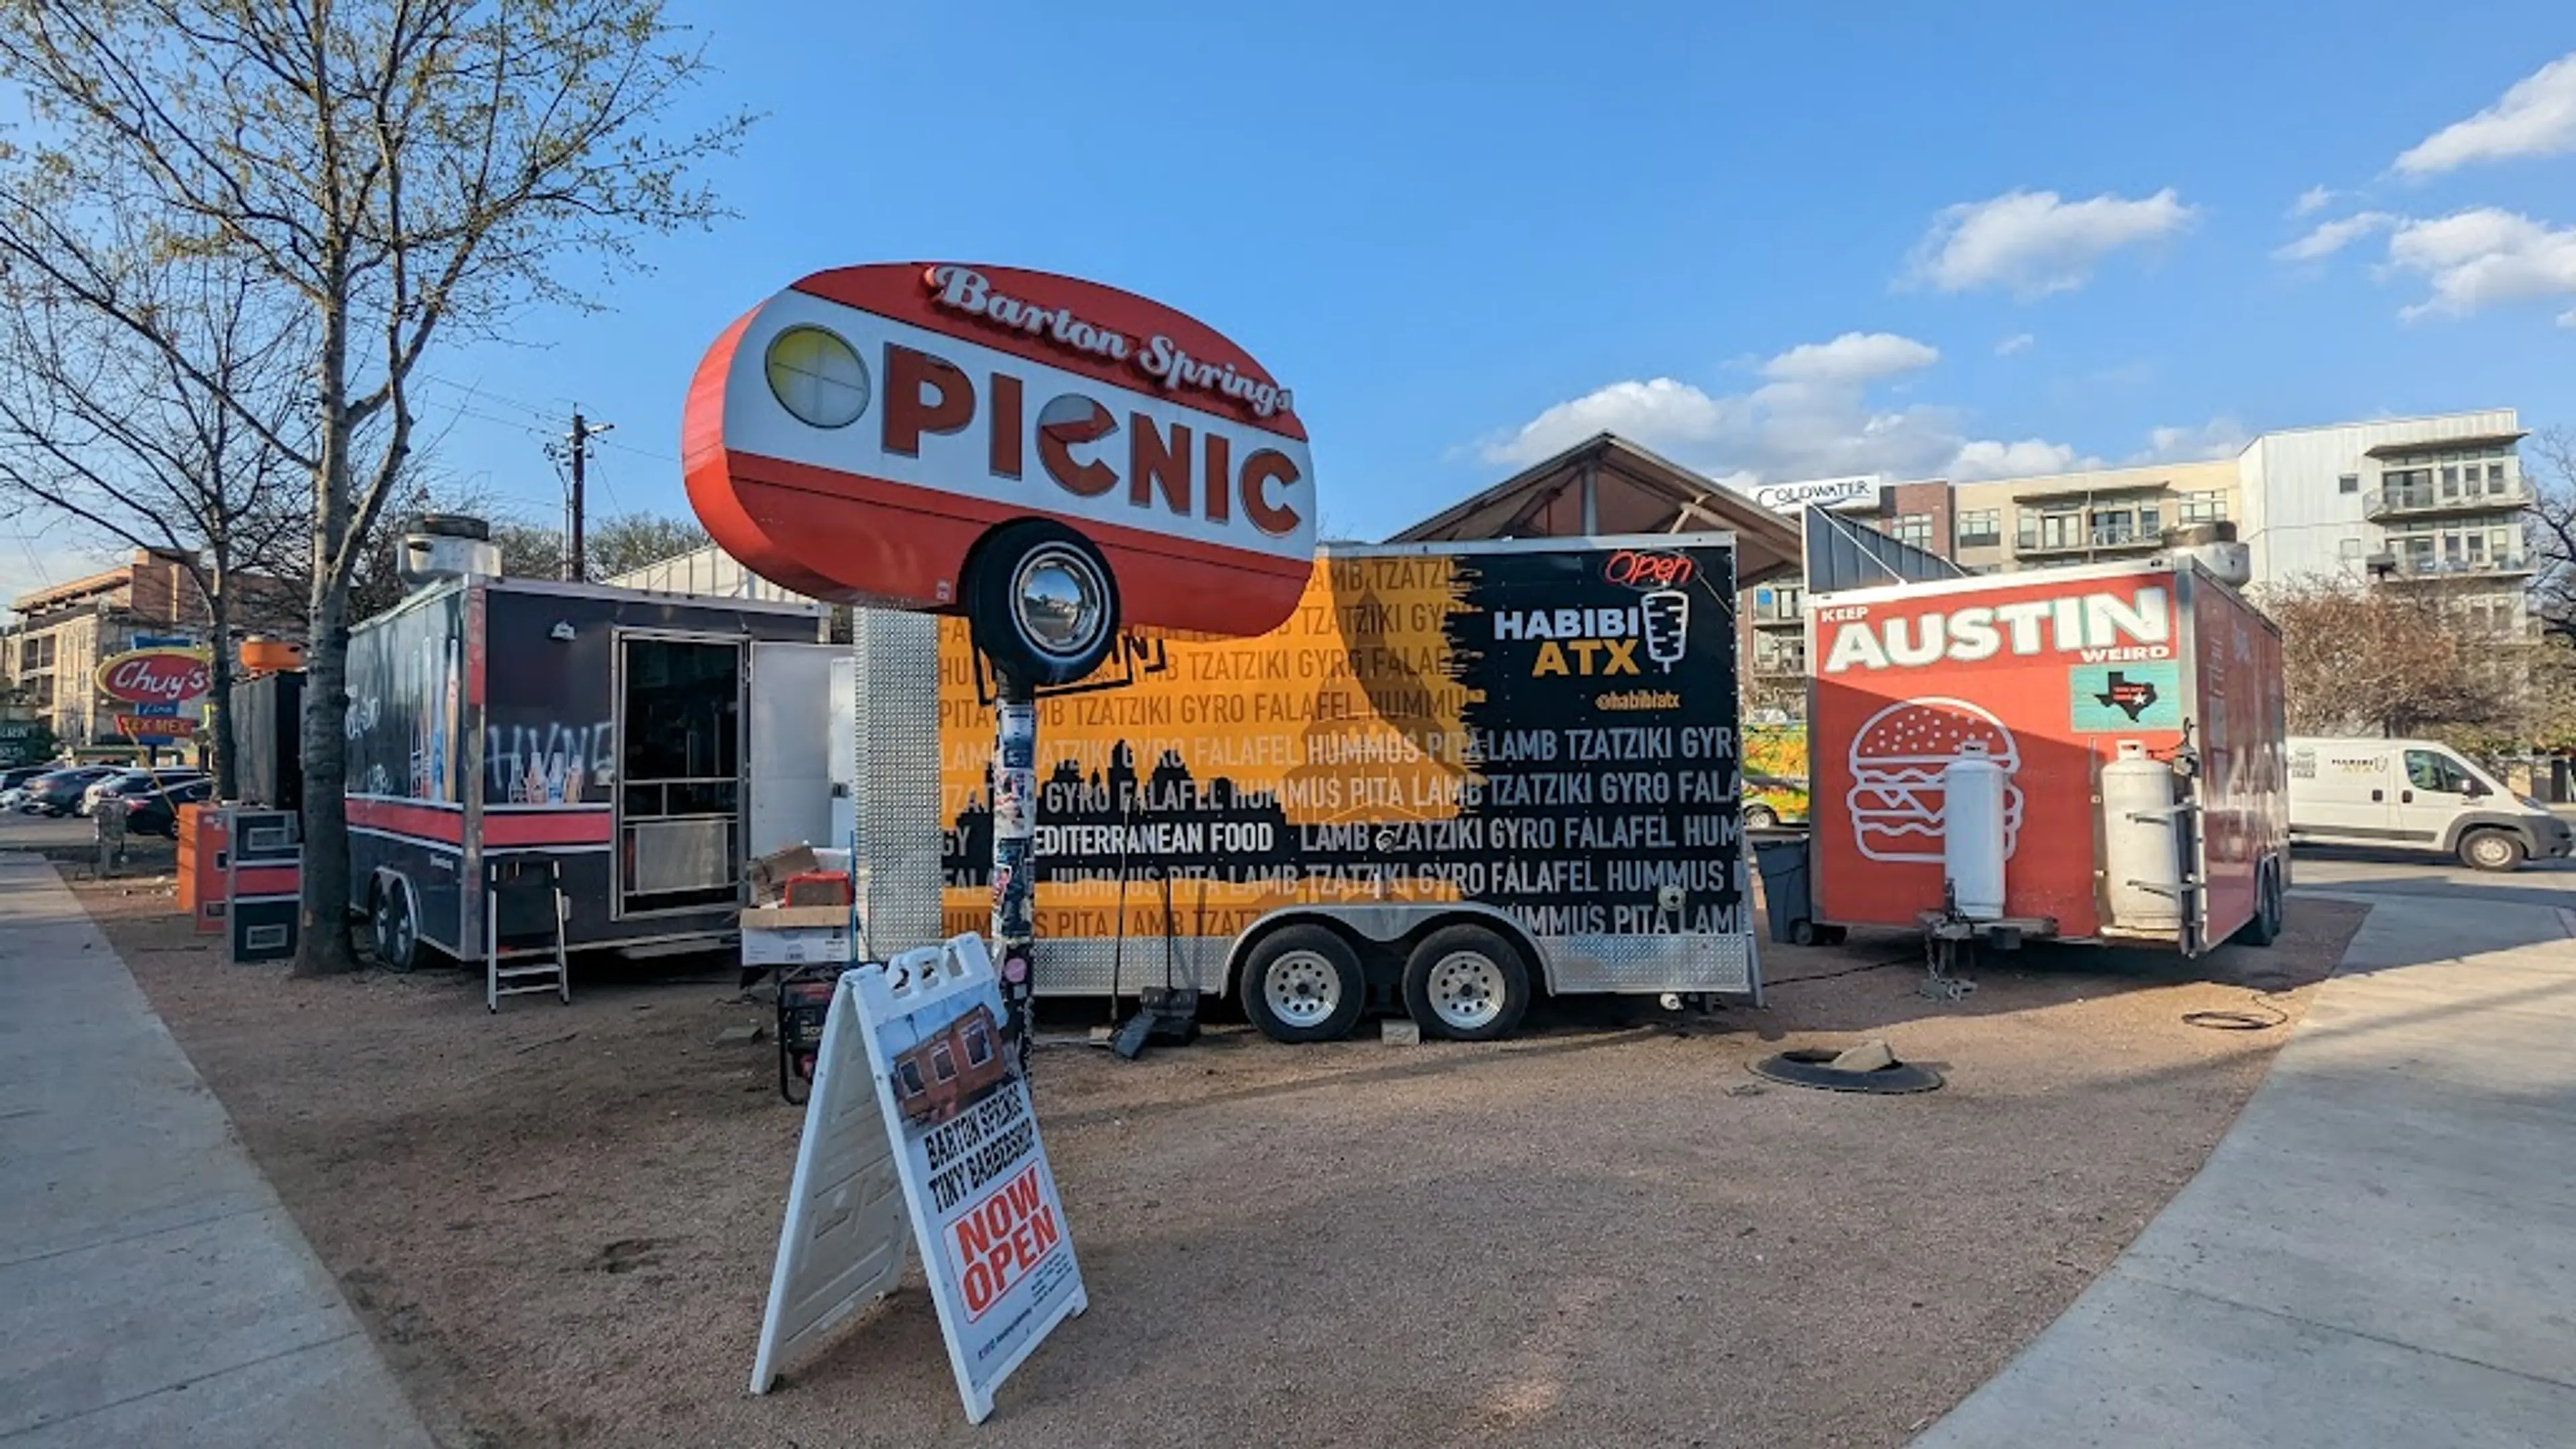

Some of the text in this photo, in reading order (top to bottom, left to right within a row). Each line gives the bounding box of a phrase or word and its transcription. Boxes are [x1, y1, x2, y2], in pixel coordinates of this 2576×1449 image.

[936, 266, 1294, 417] Barton Springs
[881, 341, 1301, 537] PICNIC
[1310, 559, 1363, 592] AMB
[1606, 550, 1692, 585] Open
[1494, 606, 1640, 639] HABIBI
[1821, 605, 1868, 623] KEEP
[1823, 586, 2171, 674] AUSTIN
[1187, 648, 1289, 682] TZATZIKI
[1297, 647, 1362, 679] GYRO
[1371, 645, 1449, 678] FALAF
[1532, 638, 1642, 677] ATX
[2080, 645, 2171, 664] WEIRD
[115, 660, 205, 700] Chuy's
[1073, 695, 1171, 727] TZATZIKI
[1180, 693, 1245, 724] GYRO
[1254, 690, 1359, 722] FALAFEL
[1368, 688, 1464, 720] HUMMU
[1037, 740, 1114, 769] ATZIKI
[1121, 737, 1185, 769] GYRO
[1194, 734, 1299, 769] FALAFEL
[1307, 731, 1420, 766] HUMMUS
[1487, 729, 1558, 762] LAMB
[1564, 727, 1673, 761] TZATZIKI
[941, 783, 996, 814] TZAT
[1046, 781, 1111, 814] GYRO
[1119, 779, 1224, 813] FALAFEL
[1230, 776, 1341, 810] HUMMUS
[1350, 776, 1405, 807] PITA
[1413, 774, 1483, 807] LAMB
[1489, 772, 1593, 806] TZATZIKI
[1601, 771, 1670, 804] GYRO
[1034, 822, 1204, 855] EDITERRANEAN
[1210, 821, 1274, 854] FOOD
[1300, 820, 1370, 853] LAMB
[1490, 816, 1556, 850] GYRO
[1564, 815, 1676, 849] FALAFEL
[1051, 865, 1161, 898] HUMMUS
[1228, 863, 1299, 897] LAMB
[1305, 862, 1408, 896] TZATZIKI
[1418, 861, 1486, 896] GYRO
[1491, 860, 1600, 894] FALAFEL
[1607, 859, 1725, 893] HUMMUS
[1058, 910, 1108, 938] PITA
[1193, 906, 1264, 936] TZAT
[1614, 903, 1671, 934] PITA
[924, 1109, 983, 1171] BARTON
[928, 1161, 967, 1214] TINY
[955, 1167, 1040, 1266] NOW
[963, 1205, 1058, 1312] OPEN
